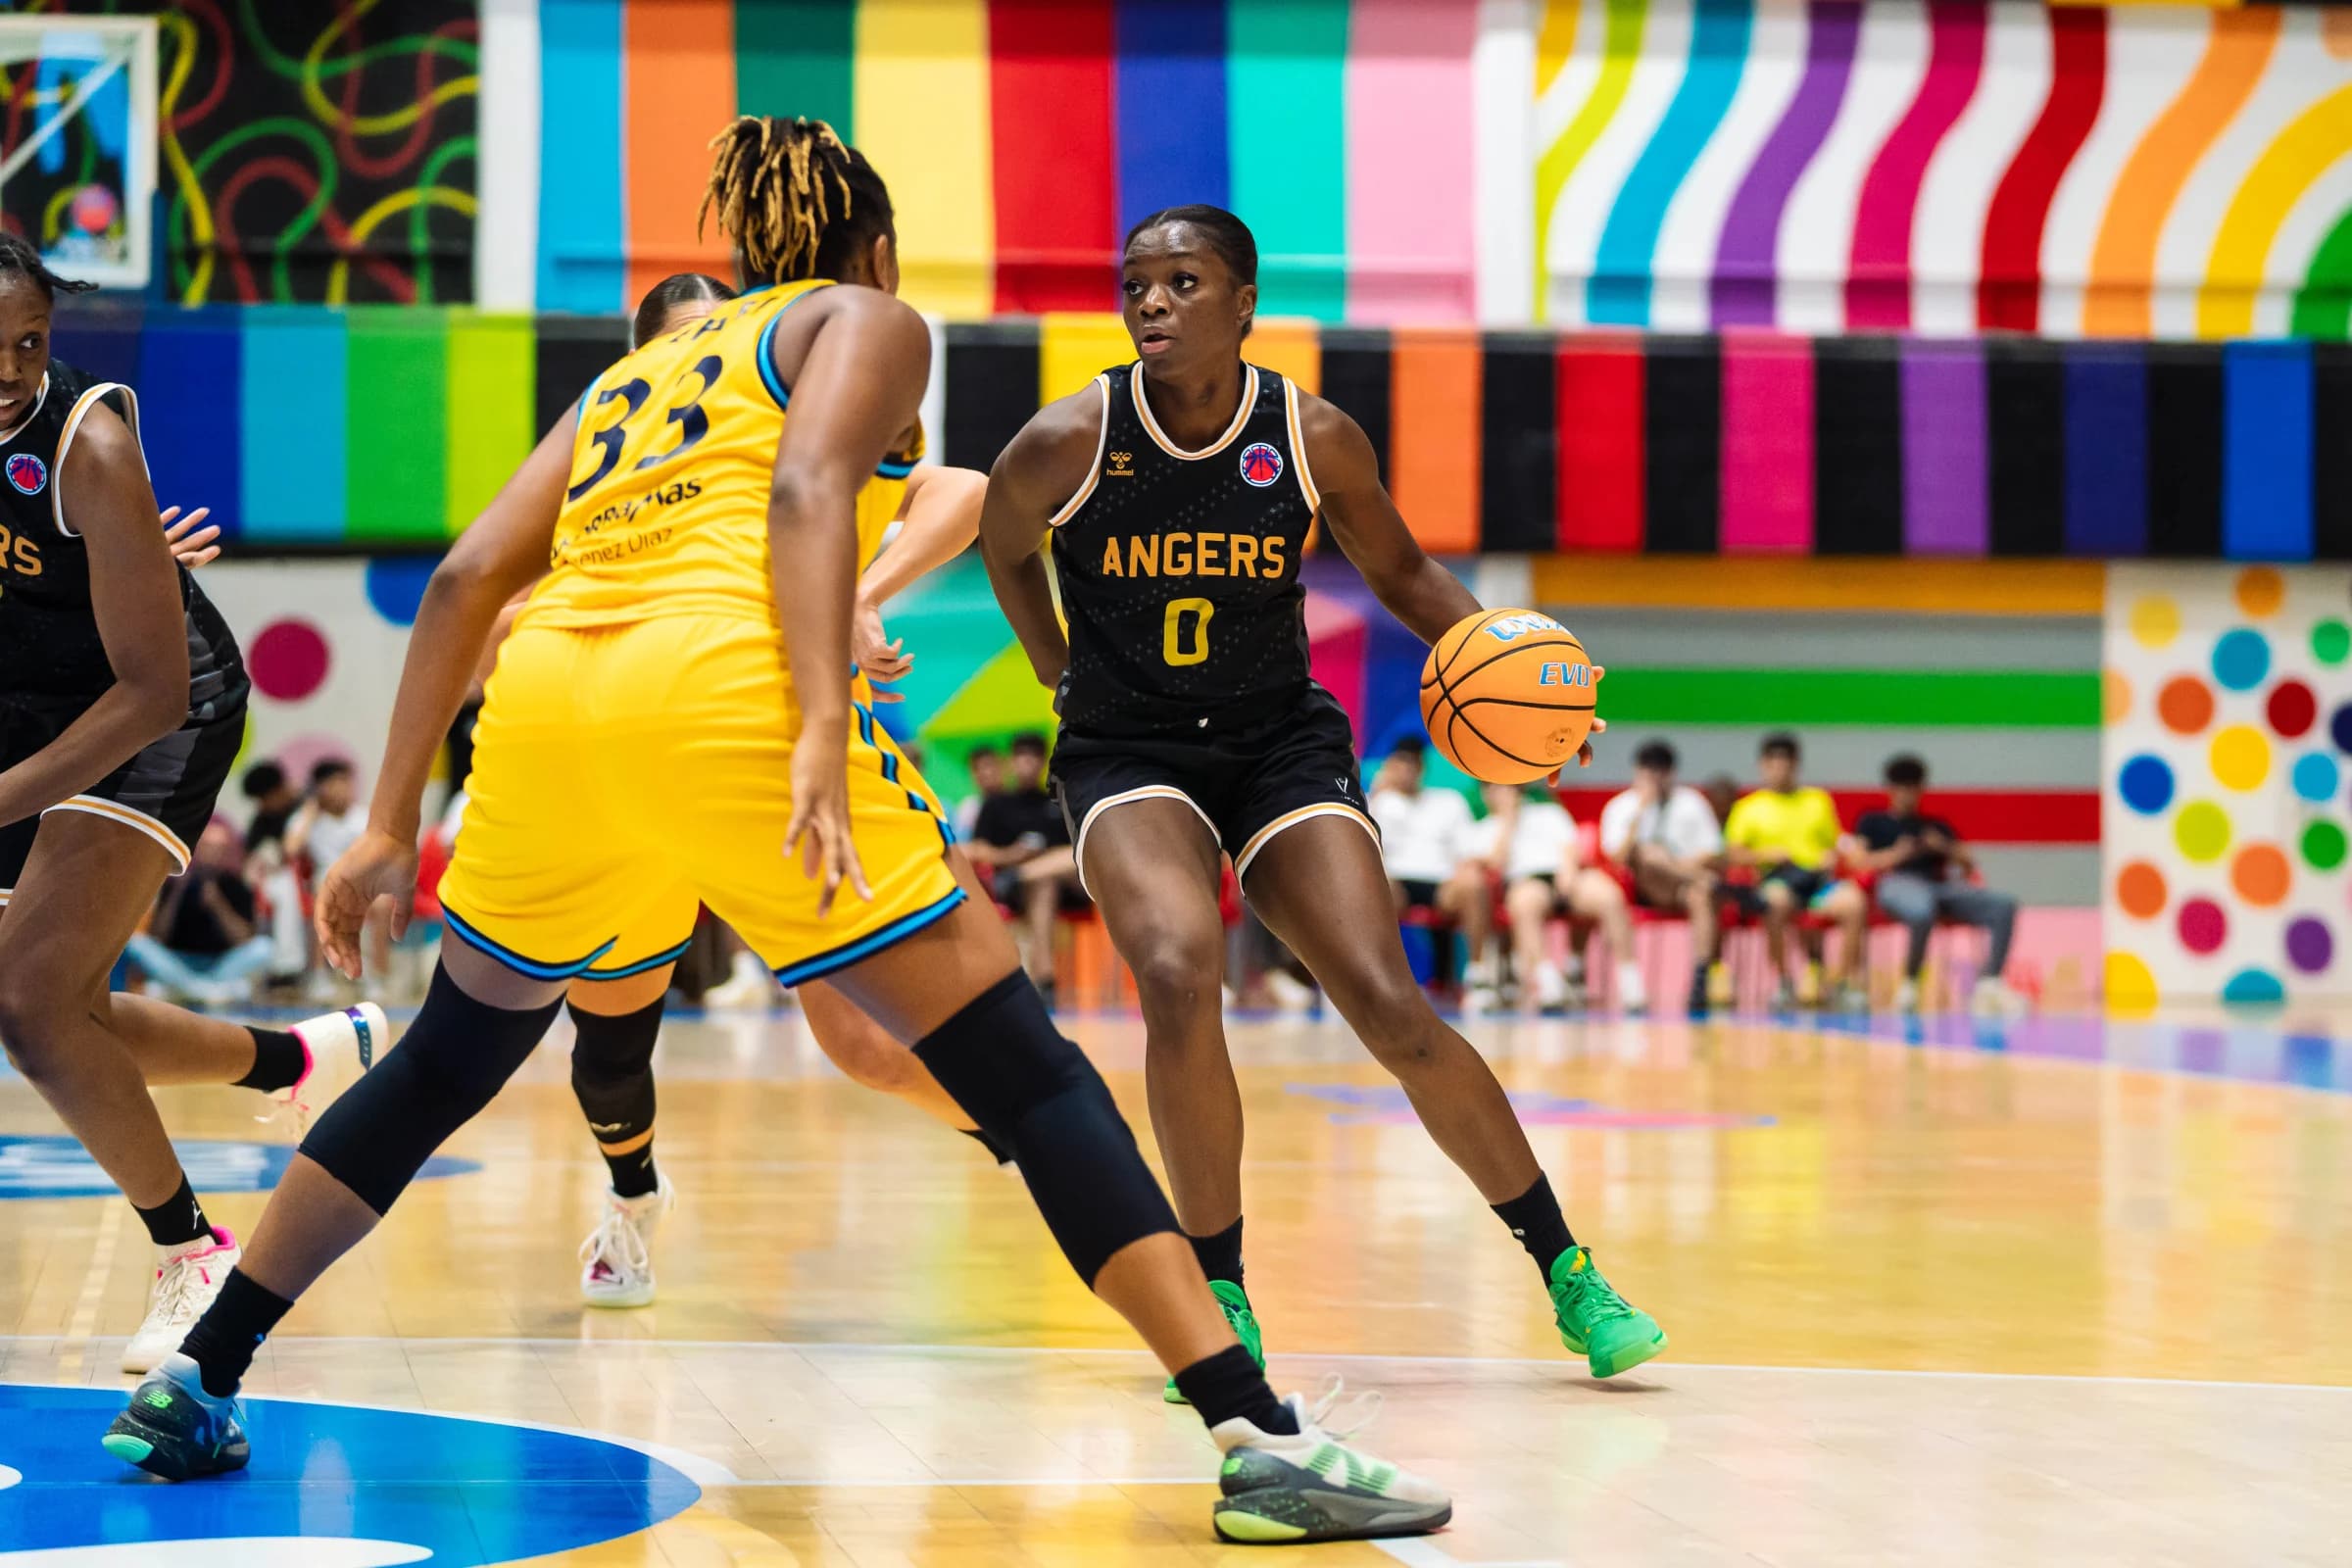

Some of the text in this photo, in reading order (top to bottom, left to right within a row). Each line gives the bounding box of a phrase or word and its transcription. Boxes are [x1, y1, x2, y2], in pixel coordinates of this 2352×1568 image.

[567, 354, 723, 503] 33
[1105, 467, 1135, 476] hummel
[1102, 531, 1286, 579] ANGERS
[1162, 597, 1214, 666] 0
